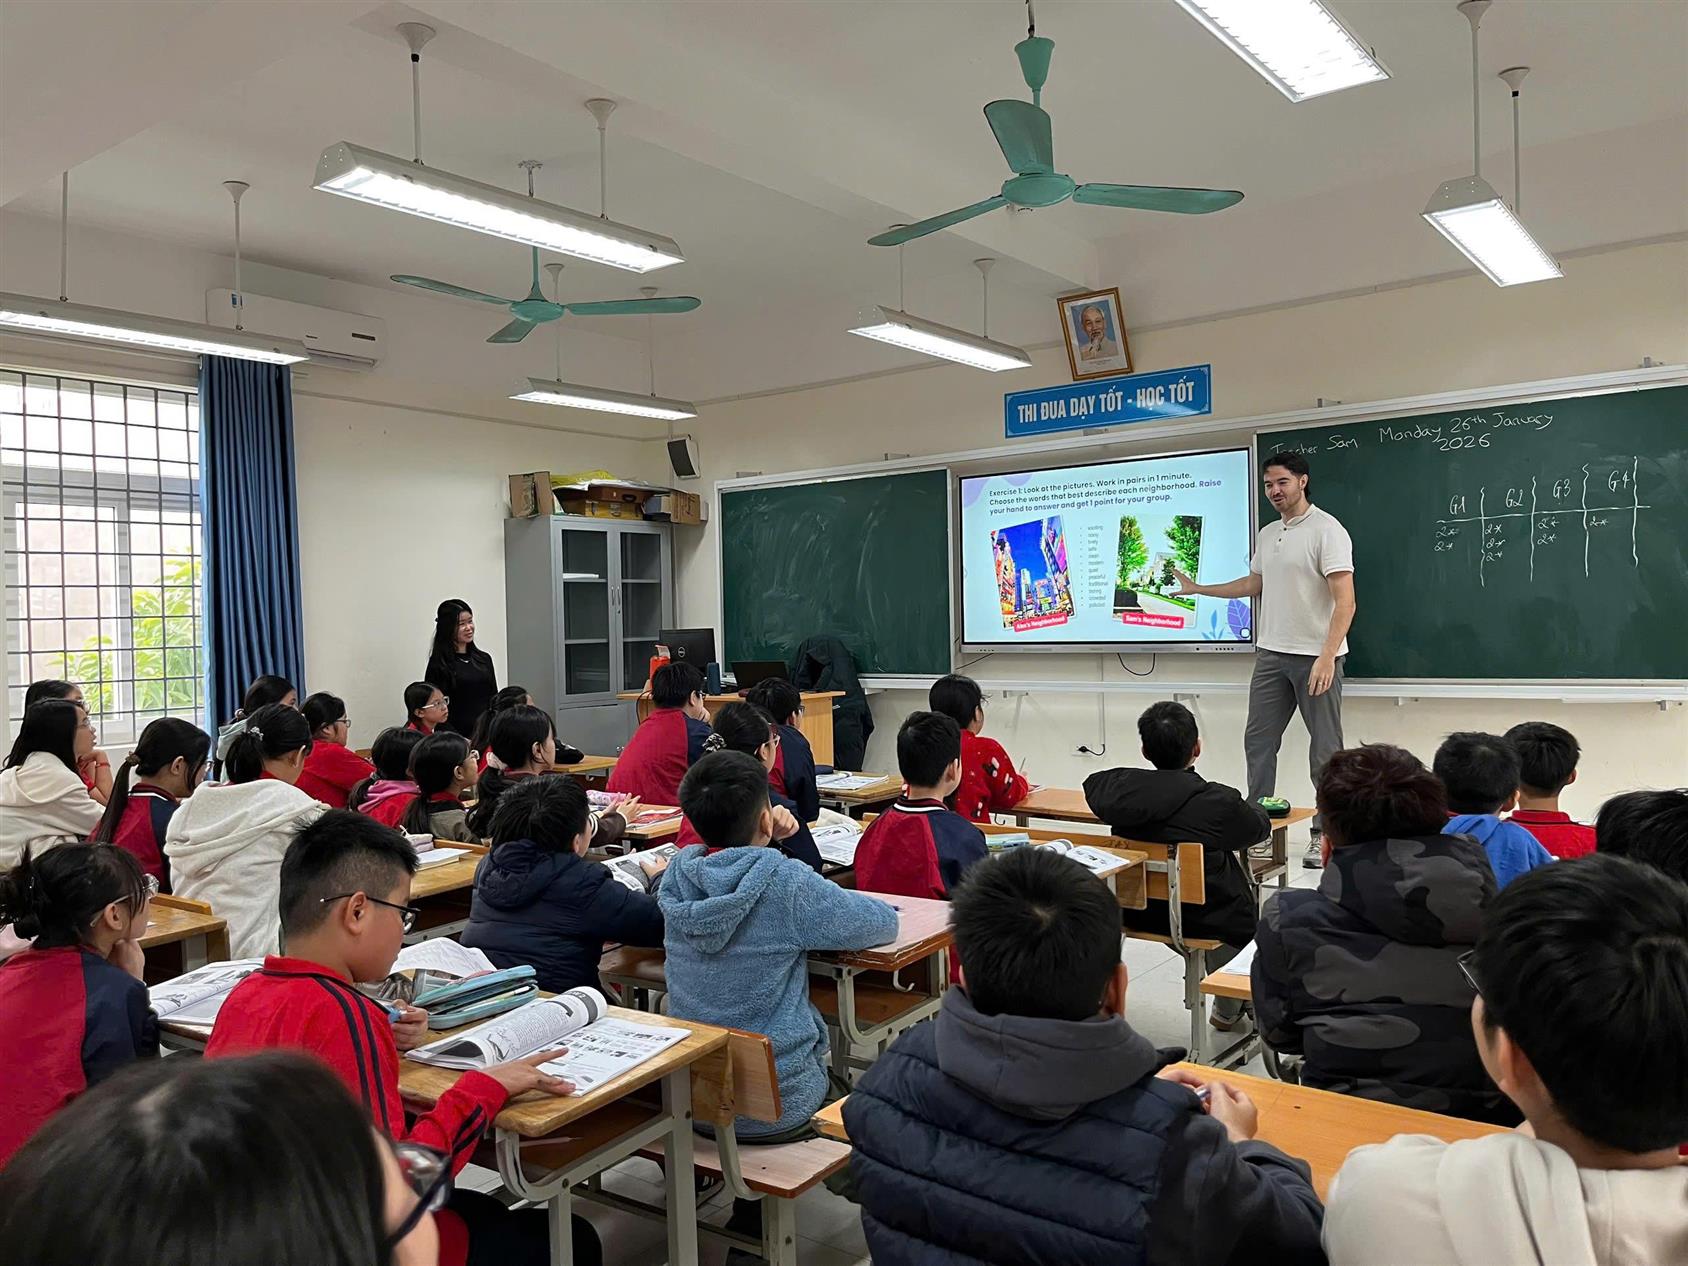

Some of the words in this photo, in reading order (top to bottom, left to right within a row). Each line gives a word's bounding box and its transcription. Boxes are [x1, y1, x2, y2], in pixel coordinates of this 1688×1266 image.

[1017, 404, 1037, 423] THI
[1040, 399, 1066, 420] ĐUA
[1070, 395, 1096, 420] DẠY
[1099, 385, 1123, 413] TỐT
[1136, 386, 1165, 411] HỌC
[1168, 376, 1195, 403] TỐT
[1379, 424, 1442, 443] Monday
[1450, 415, 1487, 433] 26th
[1492, 412, 1554, 431] January
[1326, 434, 1359, 450] Sam
[1438, 433, 1491, 452] 2026
[989, 488, 1017, 497] Exercise
[1024, 485, 1040, 494] Look
[1050, 483, 1062, 491] the
[1063, 481, 1095, 492] pictures.
[1096, 478, 1116, 487] Work
[1126, 476, 1146, 488] pairs
[1161, 473, 1192, 481] minute.
[989, 497, 1015, 506] Choose
[1028, 494, 1050, 502] words
[1051, 492, 1066, 500] that
[1067, 491, 1084, 499] best
[1085, 488, 1117, 497] describe
[1118, 486, 1138, 495] each
[1199, 480, 1222, 488] Raise
[1449, 495, 1466, 515] G1
[1505, 488, 1524, 508] G2
[1552, 479, 1571, 499] G3
[1608, 470, 1630, 492] G4
[989, 507, 1005, 516] your
[1006, 505, 1024, 513] hand
[1034, 503, 1060, 511] answer
[1061, 500, 1075, 509] and
[1076, 500, 1089, 510] get
[1094, 497, 1114, 507] point
[1127, 495, 1145, 505] your
